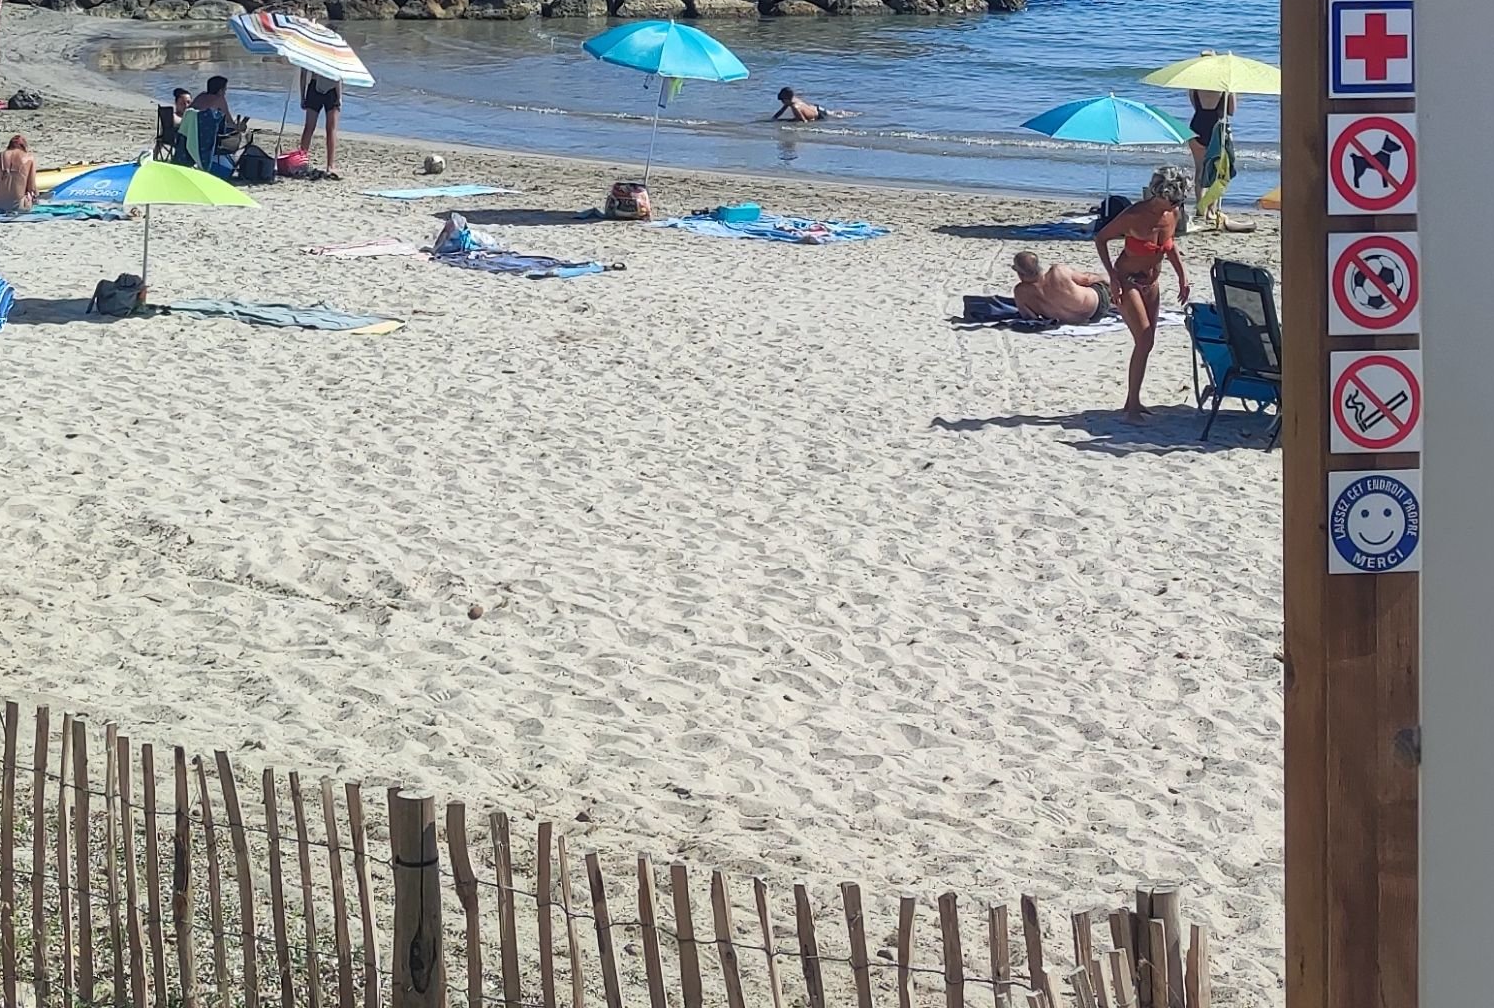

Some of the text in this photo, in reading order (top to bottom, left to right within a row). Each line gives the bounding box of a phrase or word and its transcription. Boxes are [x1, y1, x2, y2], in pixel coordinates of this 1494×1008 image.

[1334, 479, 1419, 540] LAISSEZ CET ENDROIT PROPRE
[1352, 548, 1404, 569] MERCI
